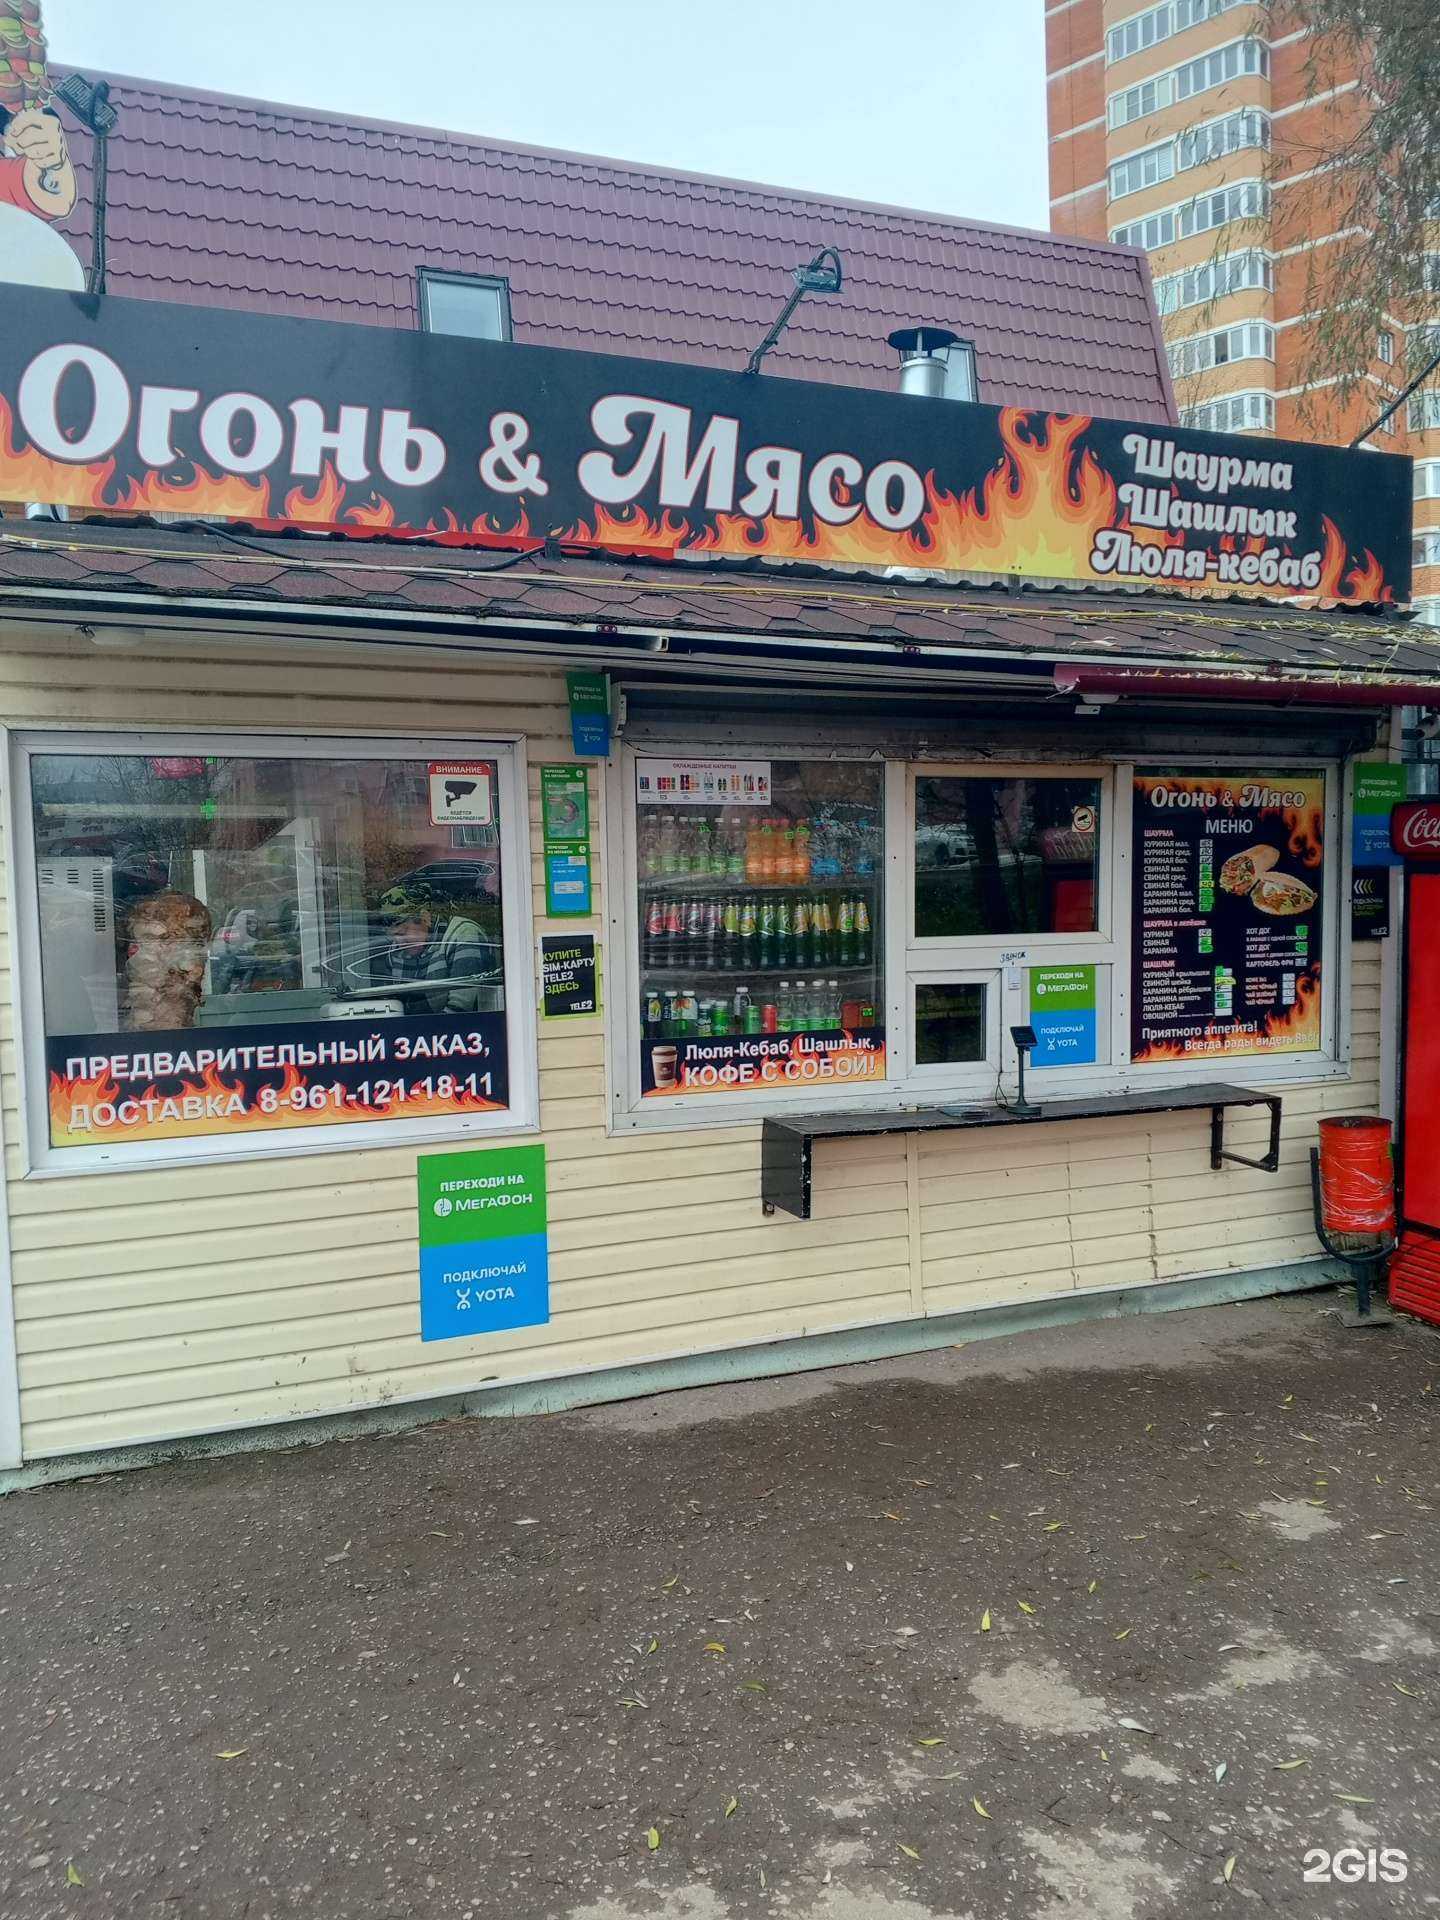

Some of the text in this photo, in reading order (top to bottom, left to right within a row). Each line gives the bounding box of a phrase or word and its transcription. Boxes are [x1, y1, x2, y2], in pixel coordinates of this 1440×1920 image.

[18, 343, 926, 532] Огонь & Мясо
[1122, 433, 1293, 494] Шаурма
[1118, 483, 1297, 539] Шашлык
[1090, 529, 1321, 588] Люля-кебаб
[435, 765, 483, 774] ВНИМАНИЕ
[1151, 784, 1306, 808] Огонь & Мясо
[1205, 819, 1253, 834] МЕНЮ
[1144, 829, 1174, 837] ШАУРМА
[1143, 920, 1172, 928] ШАУРМА
[1143, 930, 1174, 938] КУРИНАЯ
[1143, 939, 1170, 947] СВИНАЯ
[1259, 944, 1271, 952] ДОГ
[1143, 947, 1178, 955] БАРАНИНА
[543, 957, 595, 973] SIM-КАРТУ
[1143, 960, 1175, 968] ШАШЛЫК
[1246, 960, 1280, 968] КАРТОФЕЛЬ
[543, 971, 574, 983] TELE2
[1040, 972, 1074, 980] ПЕРЕХОДИ
[545, 981, 580, 994] ЗДЕСЬ
[1143, 978, 1170, 987] СВИНОЙ
[1143, 987, 1177, 995] БАРАНИНА
[1143, 995, 1177, 1003] БАРАНИНА
[569, 1000, 593, 1011] TELE2
[1143, 1003, 1185, 1011] ЛЮЛЯ-КЕБАБ
[1143, 1011, 1178, 1020] ОВОЩНОЙ
[1040, 1024, 1085, 1034] ПОДКЛЮЧАЙ
[1142, 1021, 1258, 1040] Приятного аппетита!
[1057, 1039, 1078, 1047] YOTA
[1184, 1039, 1222, 1052] Всегда
[1224, 1038, 1253, 1051] рады
[1255, 1034, 1293, 1047] видеть
[685, 1037, 876, 1061] Люля-Кебаб, Шашлык,
[66, 1032, 490, 1082] ПРЕДВАРИТЕЛЬНЫЙ ЗАКАЗ,
[685, 1052, 876, 1087] КОФЕ С СОБОЙ!
[66, 1071, 493, 1135] ДОСТАВКА 8-961-121-18-11
[440, 1174, 525, 1193] ПЕРЕХОДИ НА
[443, 1260, 527, 1284] ПОДКЛЮЧАЙ
[475, 1287, 515, 1302] YOTA
